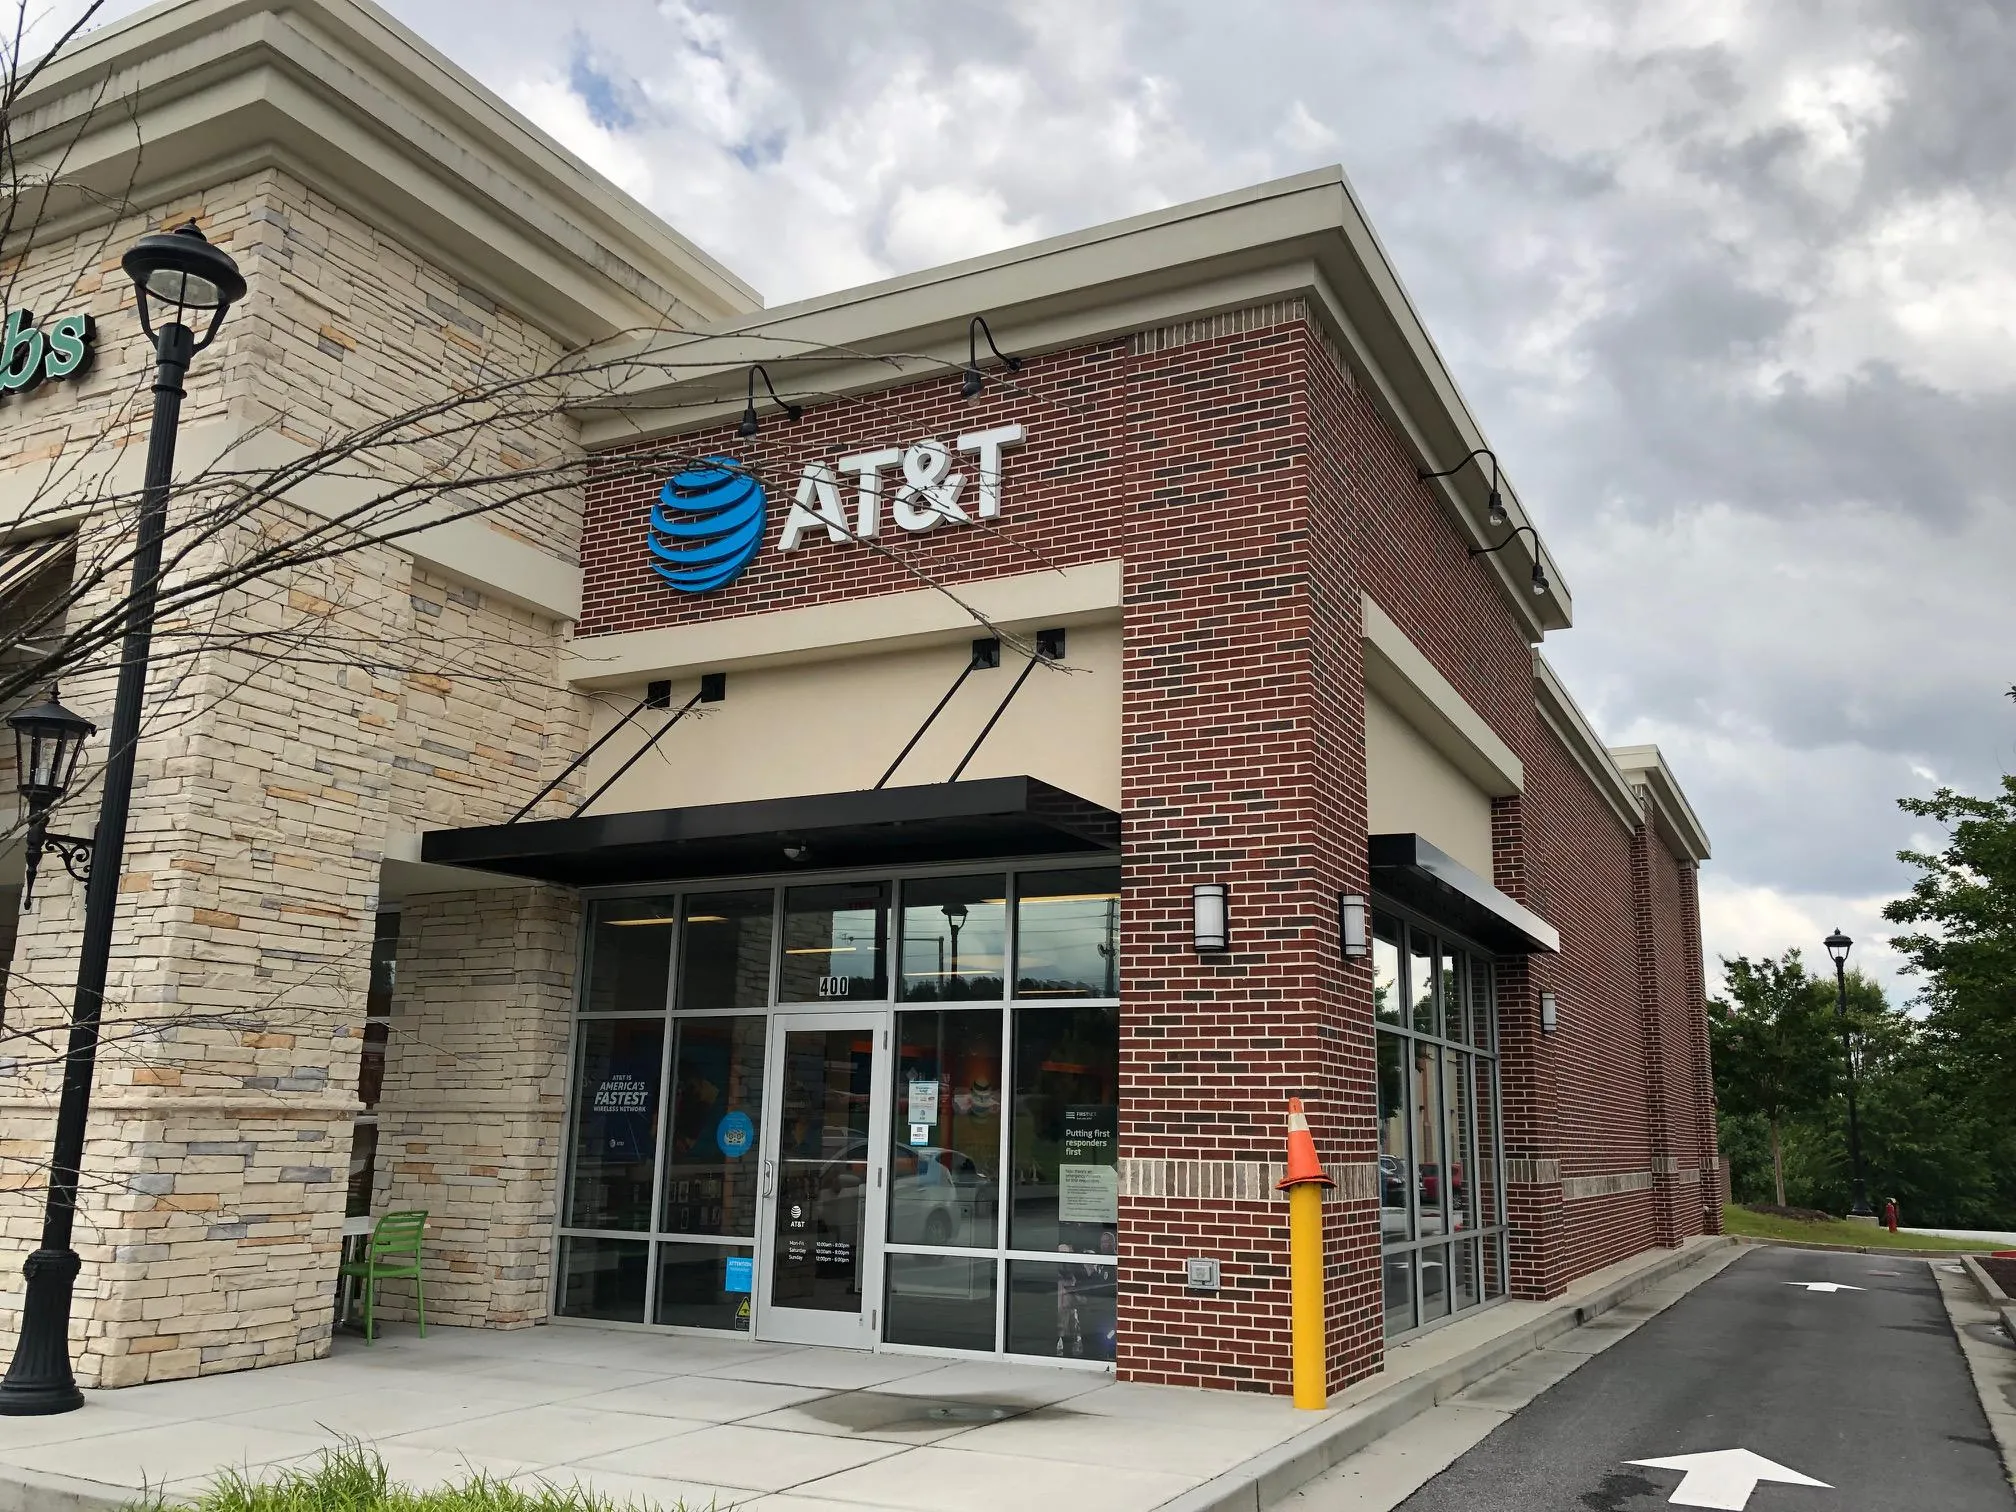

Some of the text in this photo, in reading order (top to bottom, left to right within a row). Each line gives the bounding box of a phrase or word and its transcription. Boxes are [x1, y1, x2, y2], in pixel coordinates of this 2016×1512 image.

[0, 308, 96, 392] bs
[777, 423, 1026, 552] AT&T
[820, 976, 848, 995] 400
[600, 1081, 645, 1091] AMERICA'S
[594, 1091, 649, 1106] FASTEST
[1066, 1129, 1110, 1138] Putting first
[1066, 1139, 1107, 1147] responders
[1066, 1148, 1081, 1156] first
